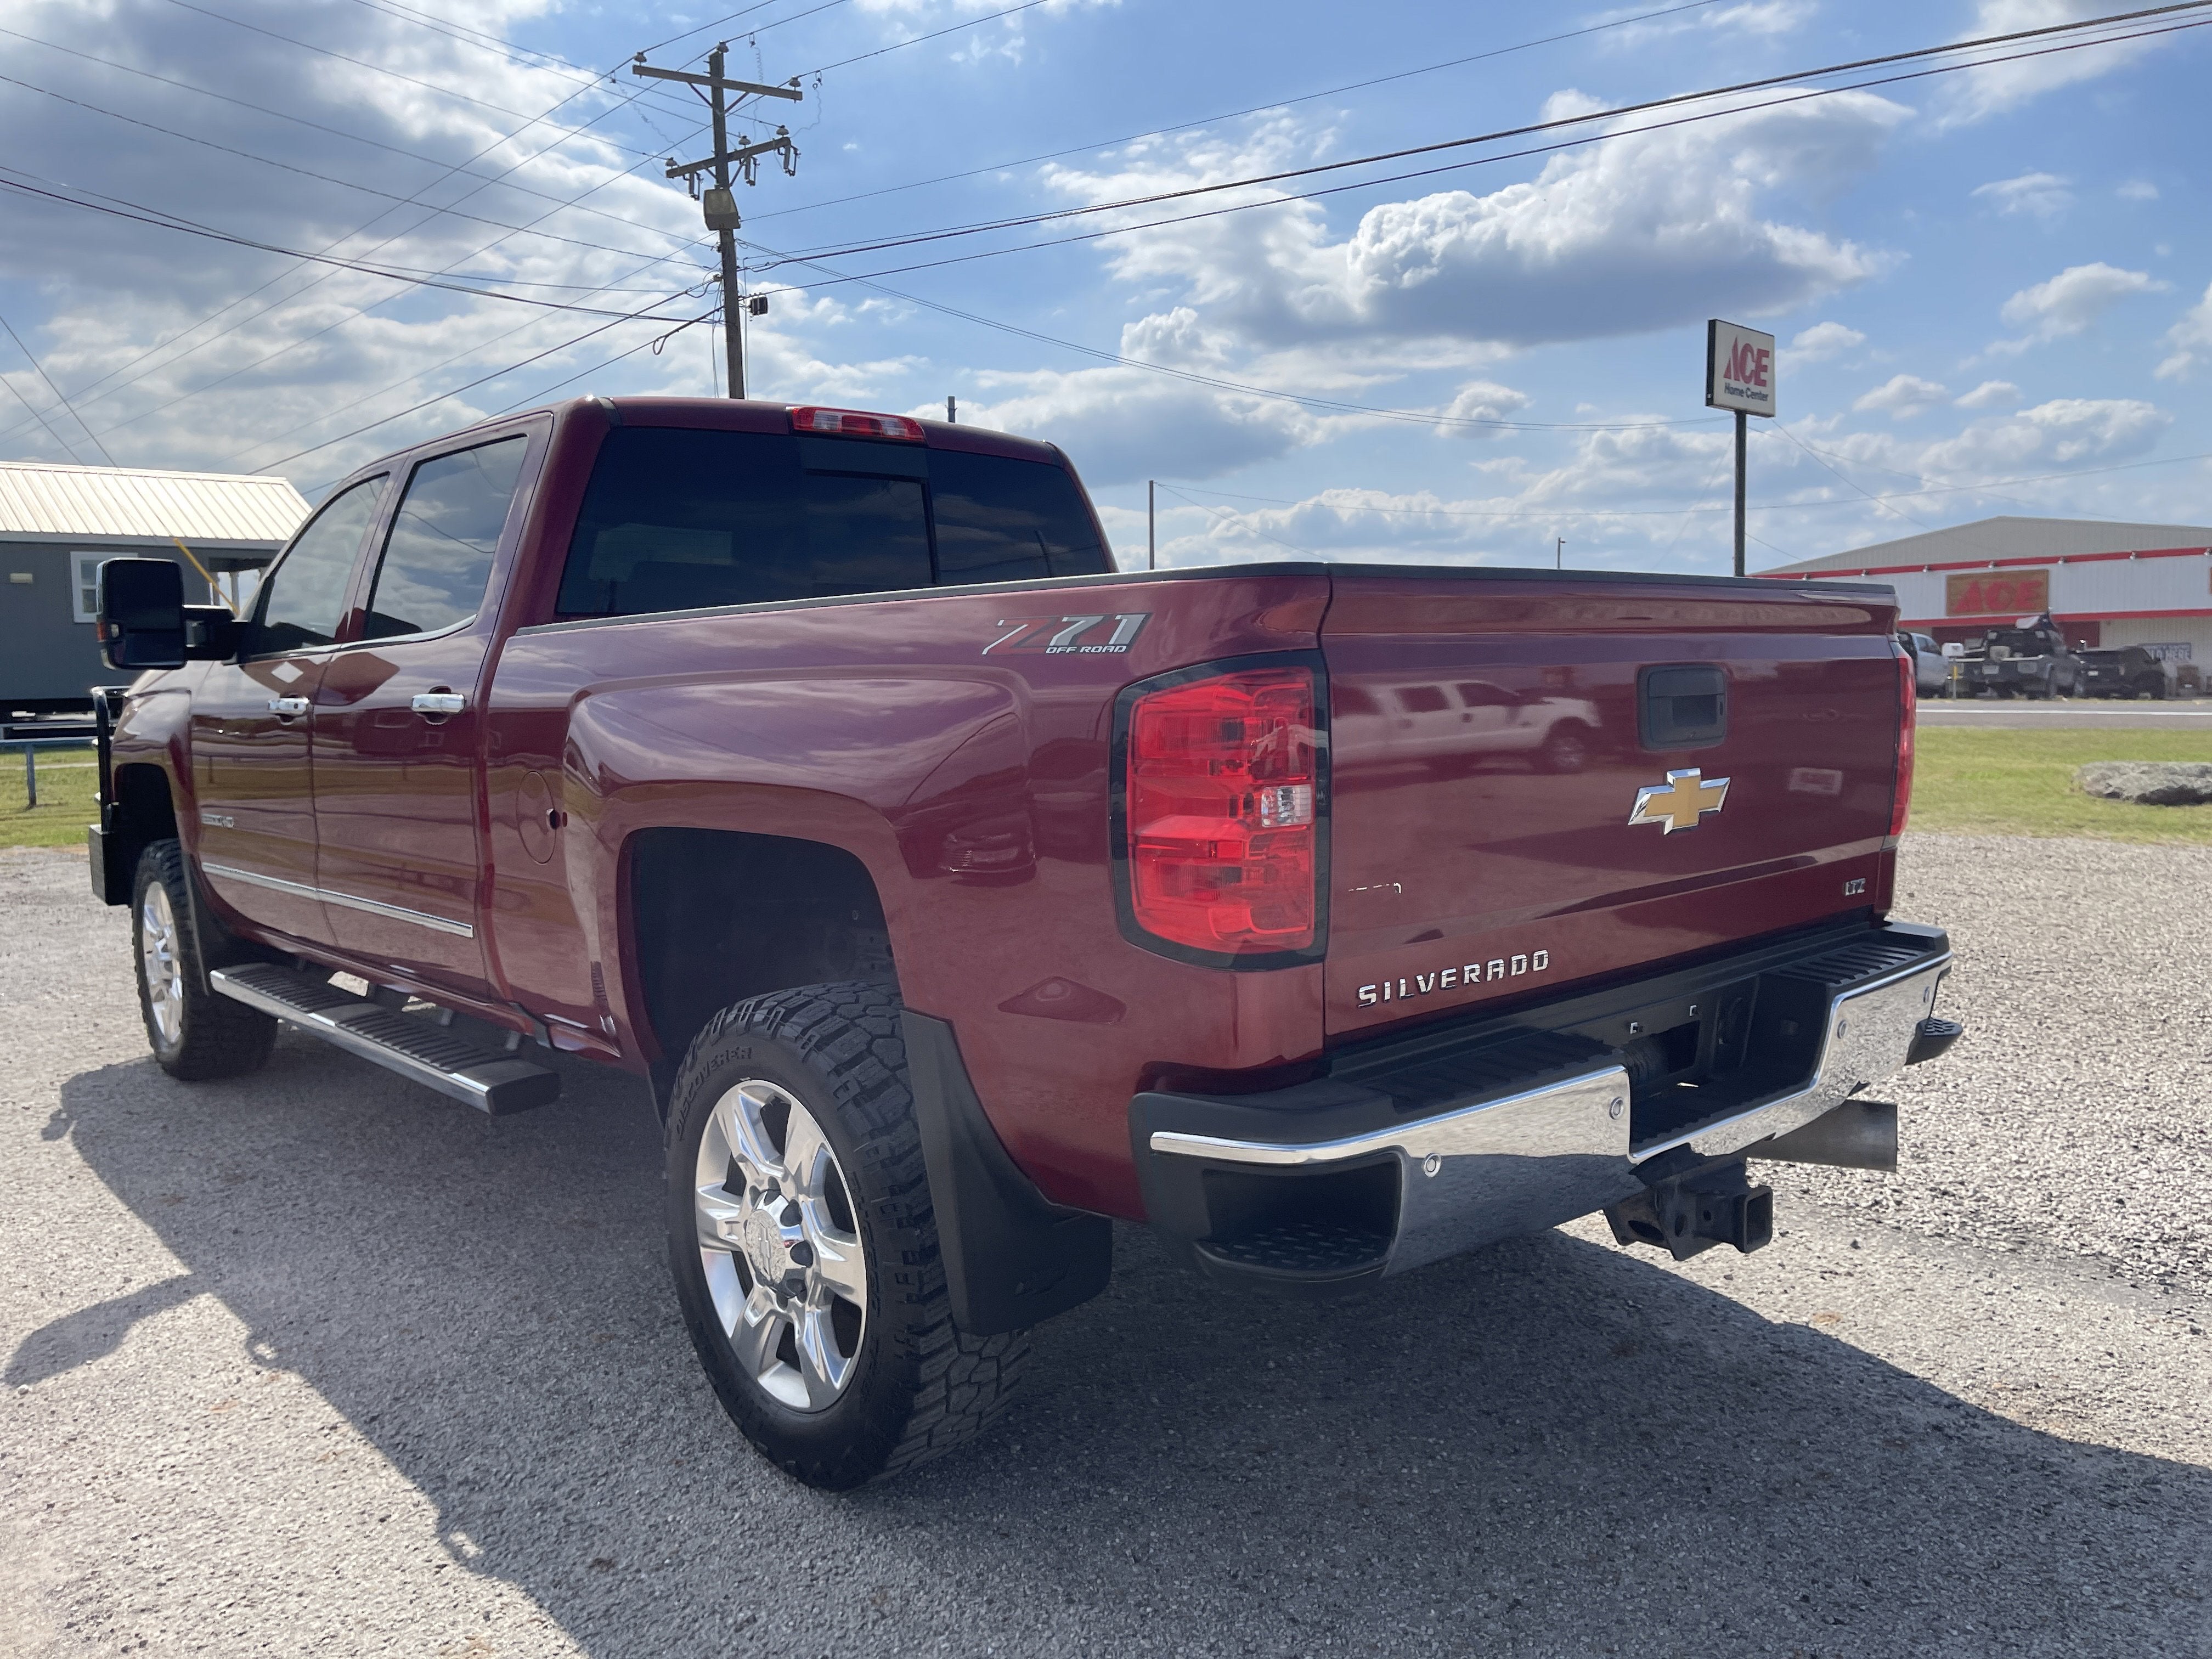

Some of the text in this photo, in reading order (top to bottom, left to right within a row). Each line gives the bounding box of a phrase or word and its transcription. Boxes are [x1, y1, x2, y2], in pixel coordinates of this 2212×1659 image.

[1723, 335, 1770, 387] ACE
[1724, 382, 1768, 402] Home Center
[1953, 580, 2042, 613] ACE
[981, 613, 1152, 656] Z71
[1045, 645, 1127, 654] OFF ROAD
[1357, 949, 1549, 1009] SILVERADO
